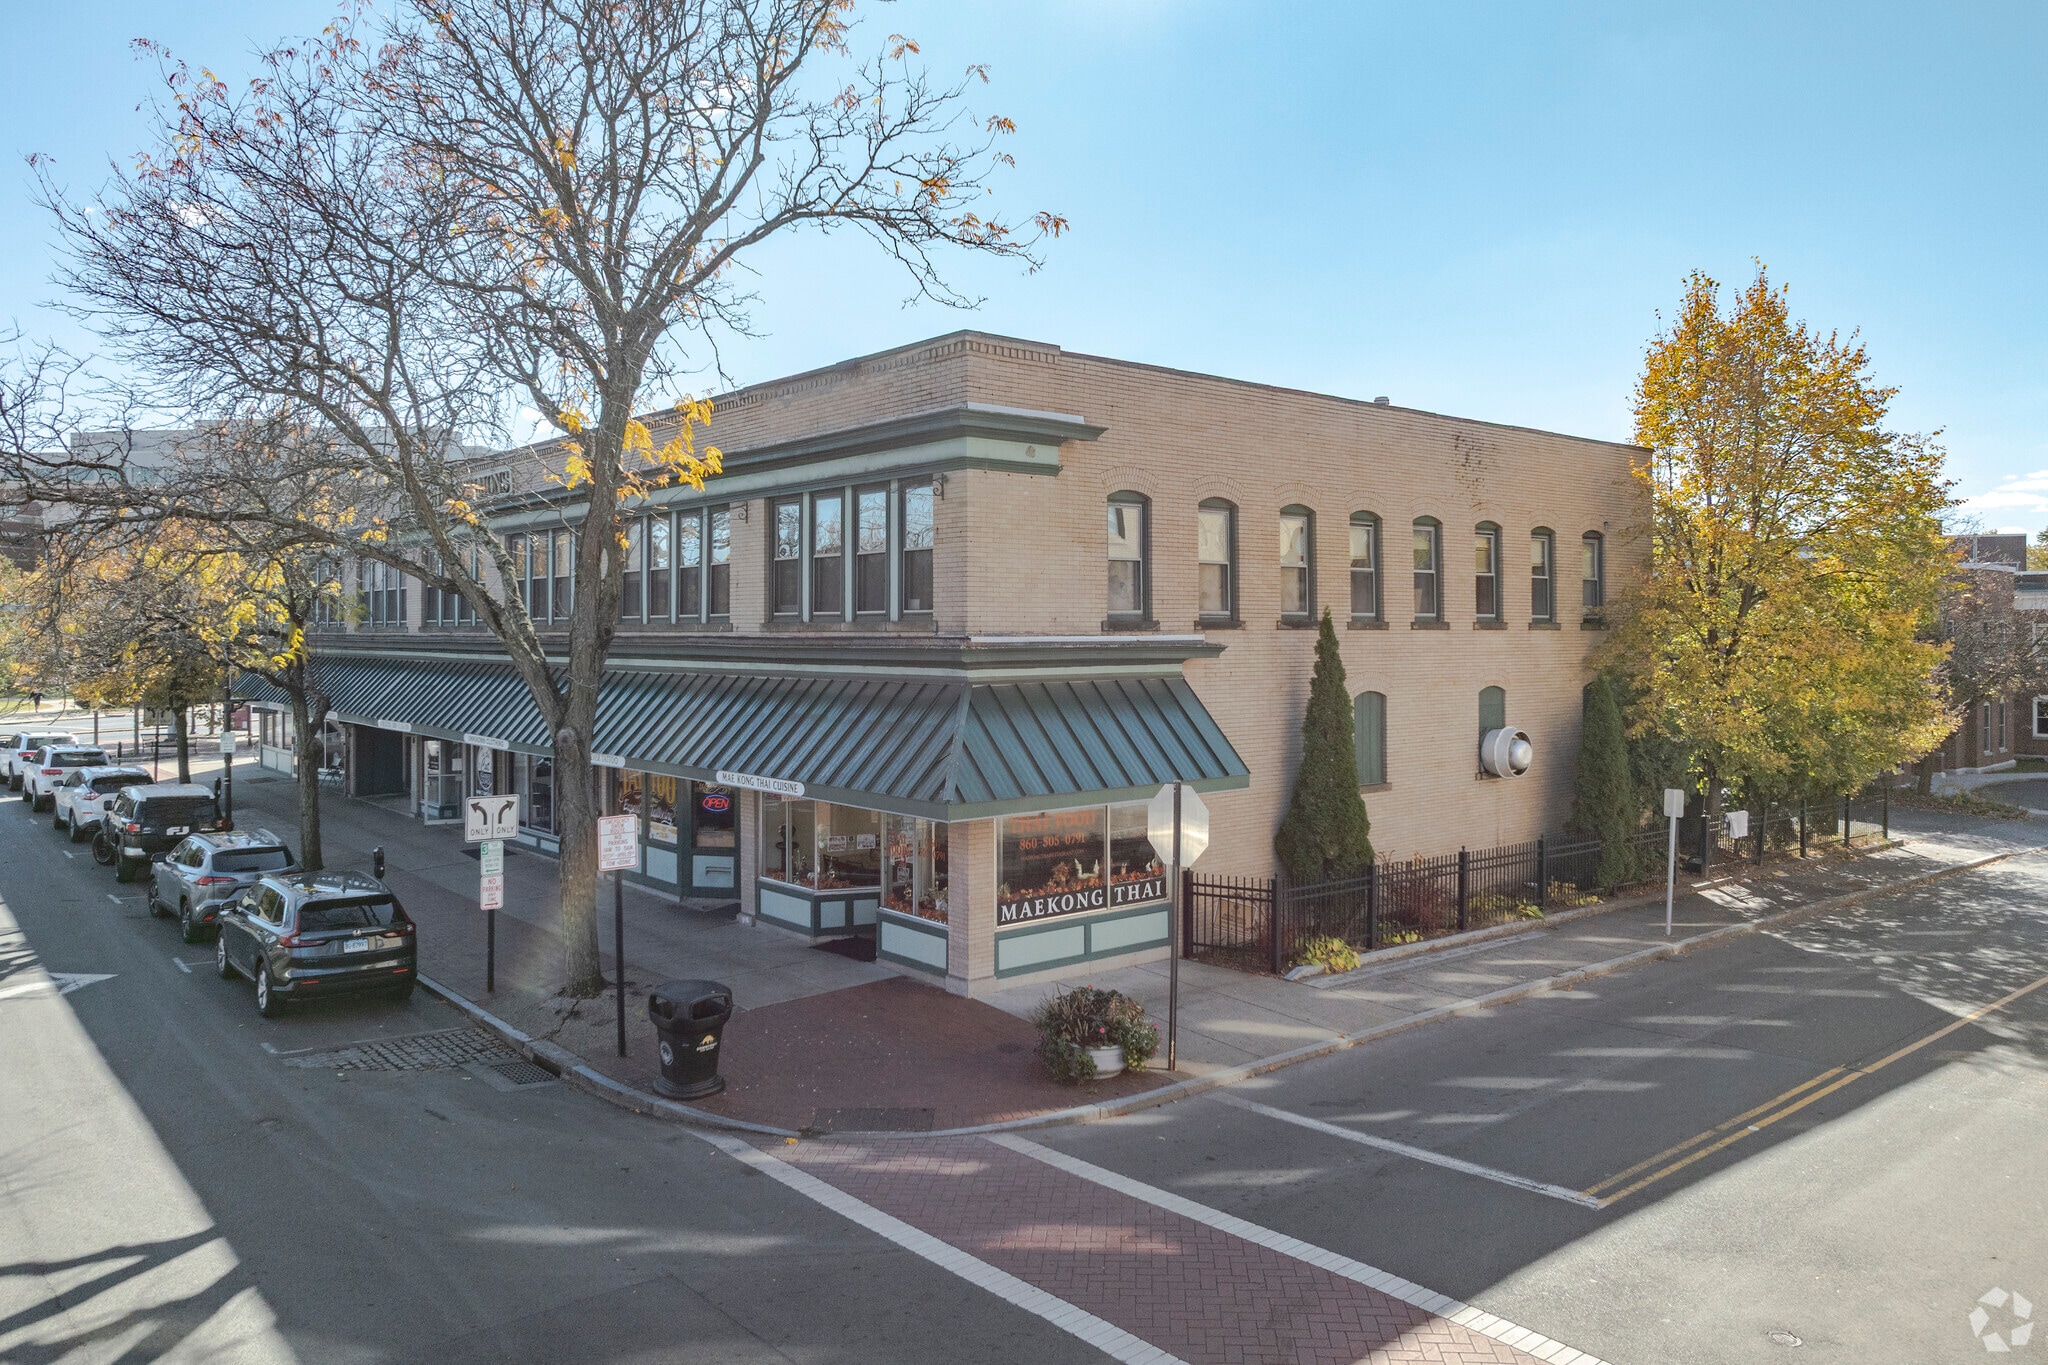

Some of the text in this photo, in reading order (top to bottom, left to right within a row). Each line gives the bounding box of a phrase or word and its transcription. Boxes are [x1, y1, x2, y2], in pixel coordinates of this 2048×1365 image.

[722, 773, 735, 783] MAE
[737, 774, 755, 787] KONG
[757, 778, 771, 789] THAI
[773, 781, 798, 794] CUISINE
[703, 798, 730, 809] OPEN
[1010, 809, 1097, 834] THAI FOOD
[471, 826, 515, 836] ONLY ONLY
[488, 878, 497, 886] NO
[482, 885, 502, 893] PARKING
[1000, 880, 1162, 922] MAEKONG THAI
